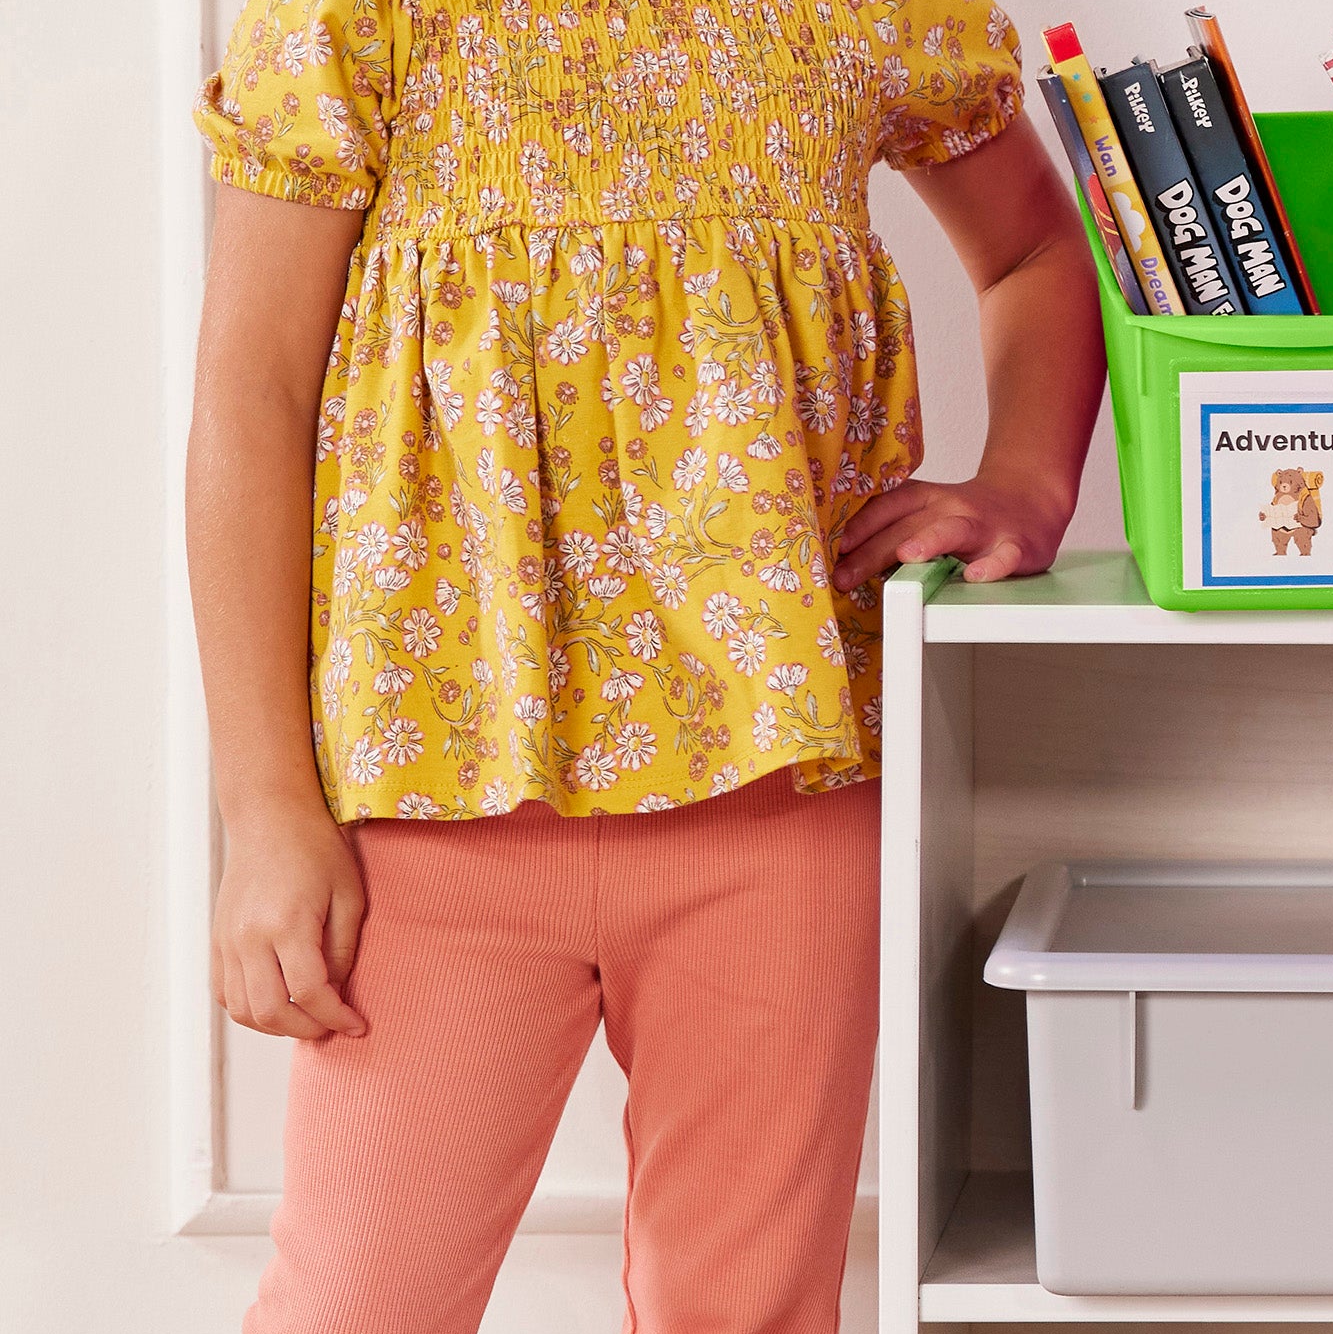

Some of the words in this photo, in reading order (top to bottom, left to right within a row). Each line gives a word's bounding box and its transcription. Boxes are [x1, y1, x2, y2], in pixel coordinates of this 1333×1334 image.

[1094, 135, 1117, 177] Wan
[1157, 179, 1206, 245] DOG
[1213, 173, 1264, 240] DOG
[1180, 244, 1230, 304] MAN
[1237, 240, 1286, 298] MAN
